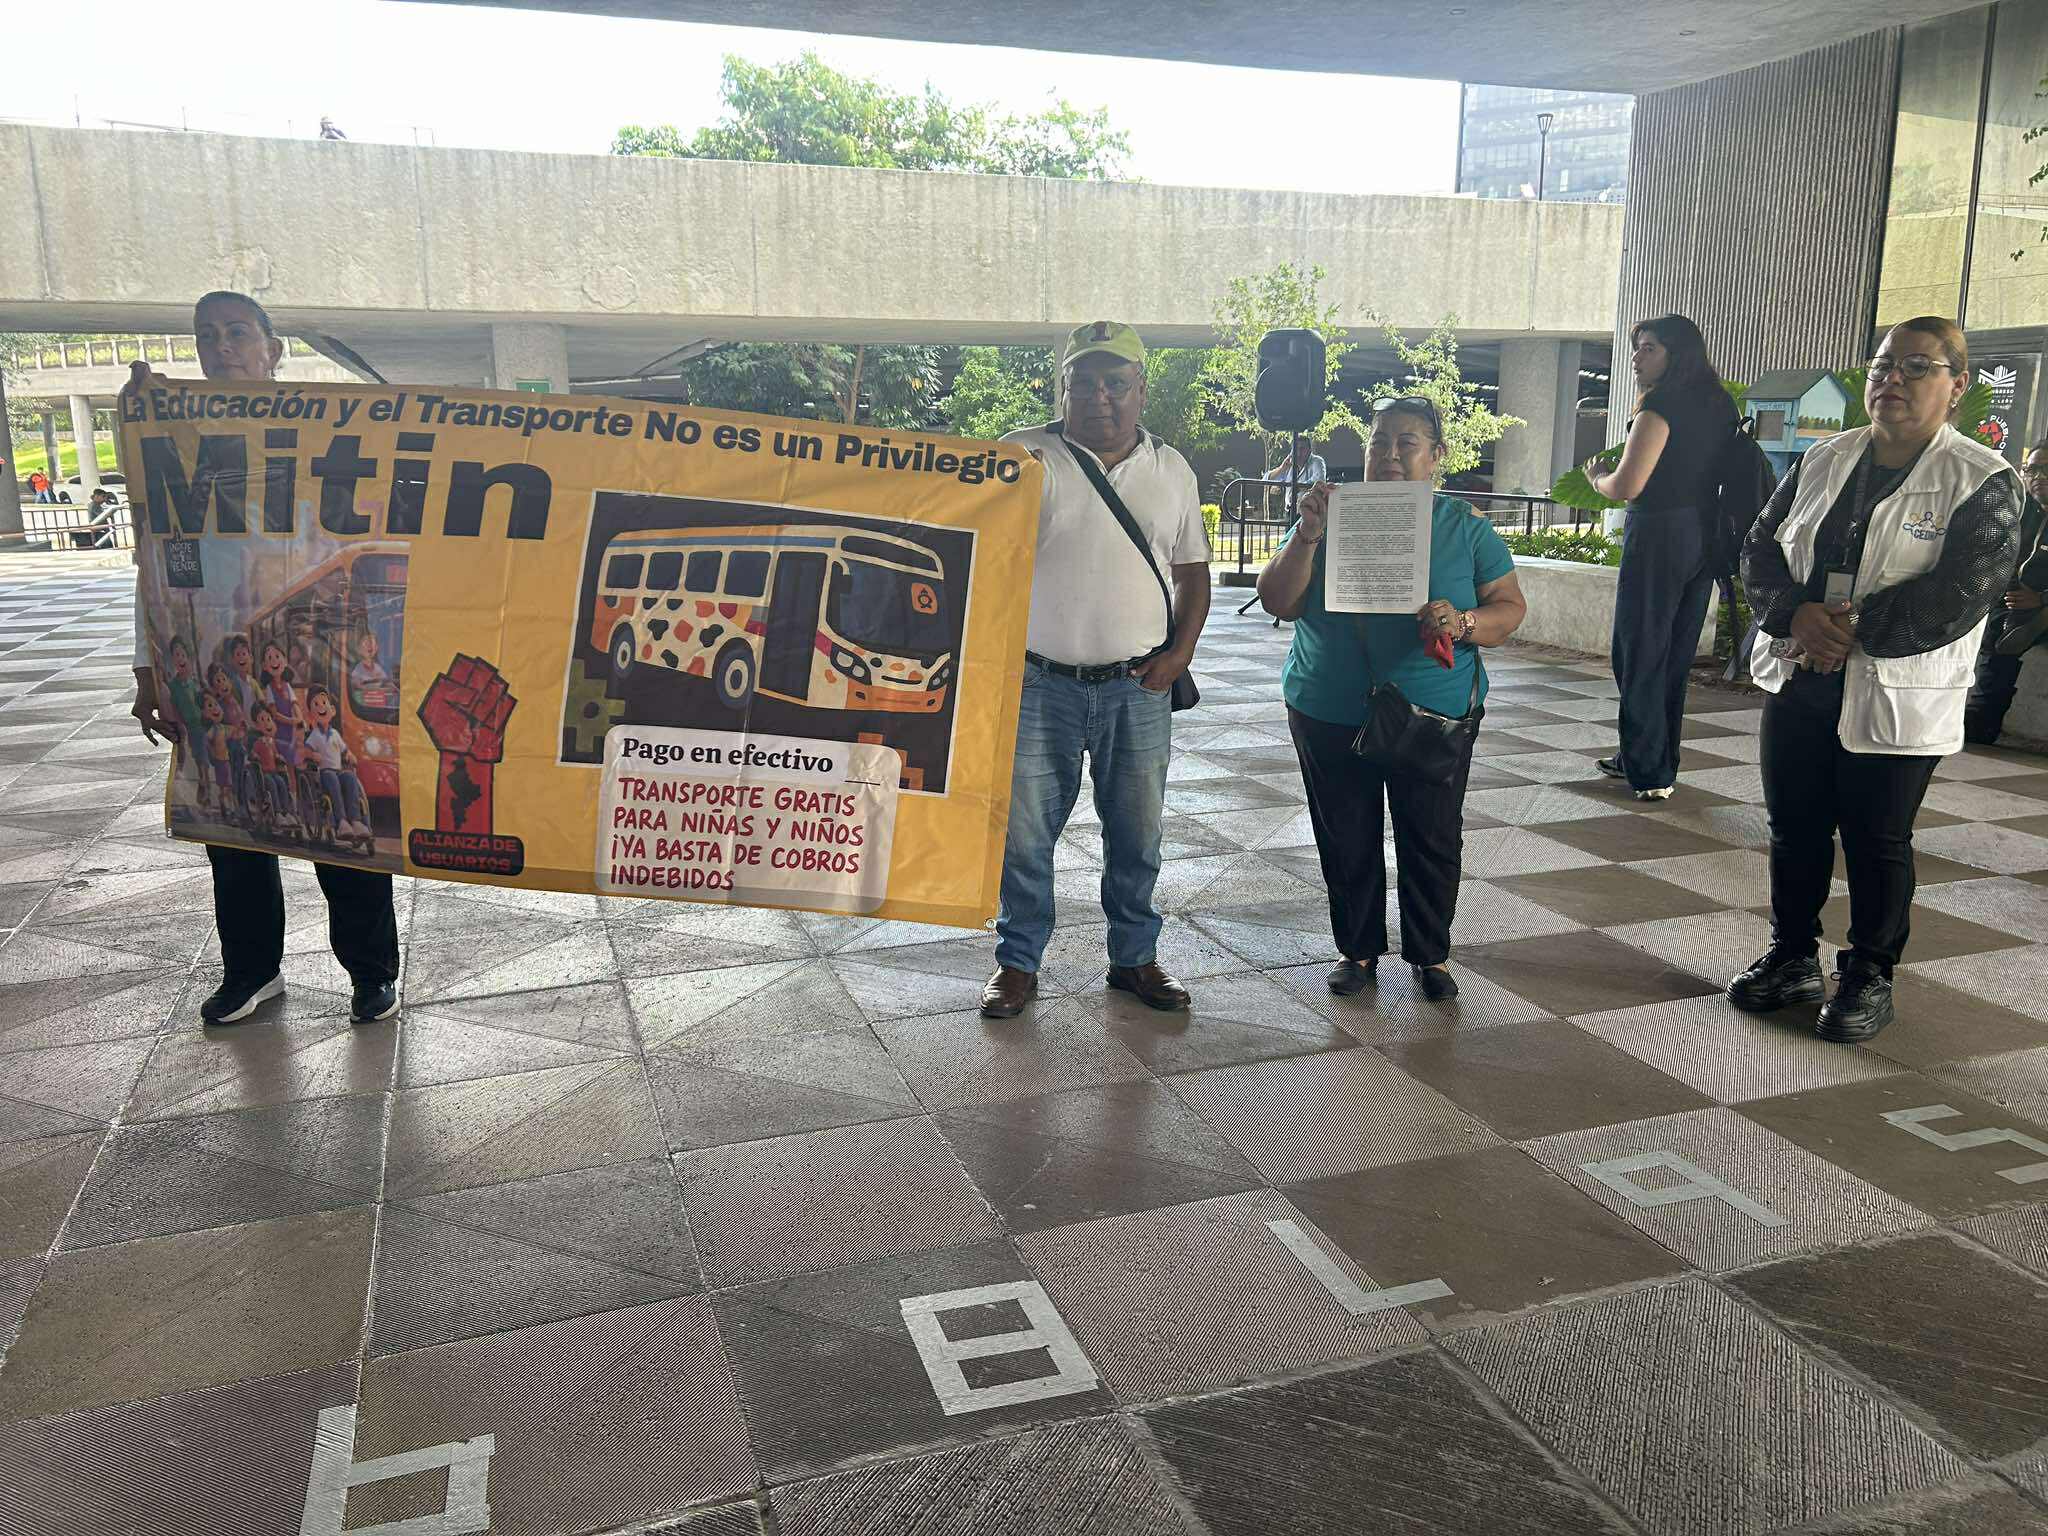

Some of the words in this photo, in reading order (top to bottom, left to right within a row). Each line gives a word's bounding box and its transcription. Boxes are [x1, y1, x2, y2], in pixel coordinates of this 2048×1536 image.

[122, 391, 147, 423] La
[151, 387, 326, 422] Educación
[333, 397, 362, 429] y
[368, 392, 408, 423] el
[416, 394, 633, 437] Transporte
[644, 410, 701, 445] No
[713, 424, 761, 452] es
[773, 431, 822, 461] un
[835, 433, 1021, 485] Privilegio
[140, 428, 552, 540] Mitin
[622, 738, 685, 765] Pago
[690, 747, 721, 764] en
[728, 744, 833, 773] efectivo
[618, 777, 764, 809] TRANSPORTE
[774, 787, 856, 817] GRATIS
[414, 832, 490, 850] ALIANZA
[493, 839, 518, 853] DE
[613, 806, 668, 831] PARA
[681, 808, 754, 836] NIÑAS
[766, 817, 781, 839] Y
[791, 818, 864, 846] NIÑOS
[419, 851, 512, 871] USUARIOS
[611, 834, 646, 860] ¡YA
[655, 838, 722, 864] BASTA
[734, 843, 763, 865] DE
[770, 847, 859, 874] COBROS
[610, 864, 735, 891] INDEBIDOS
[900, 1280, 1101, 1416] 8
